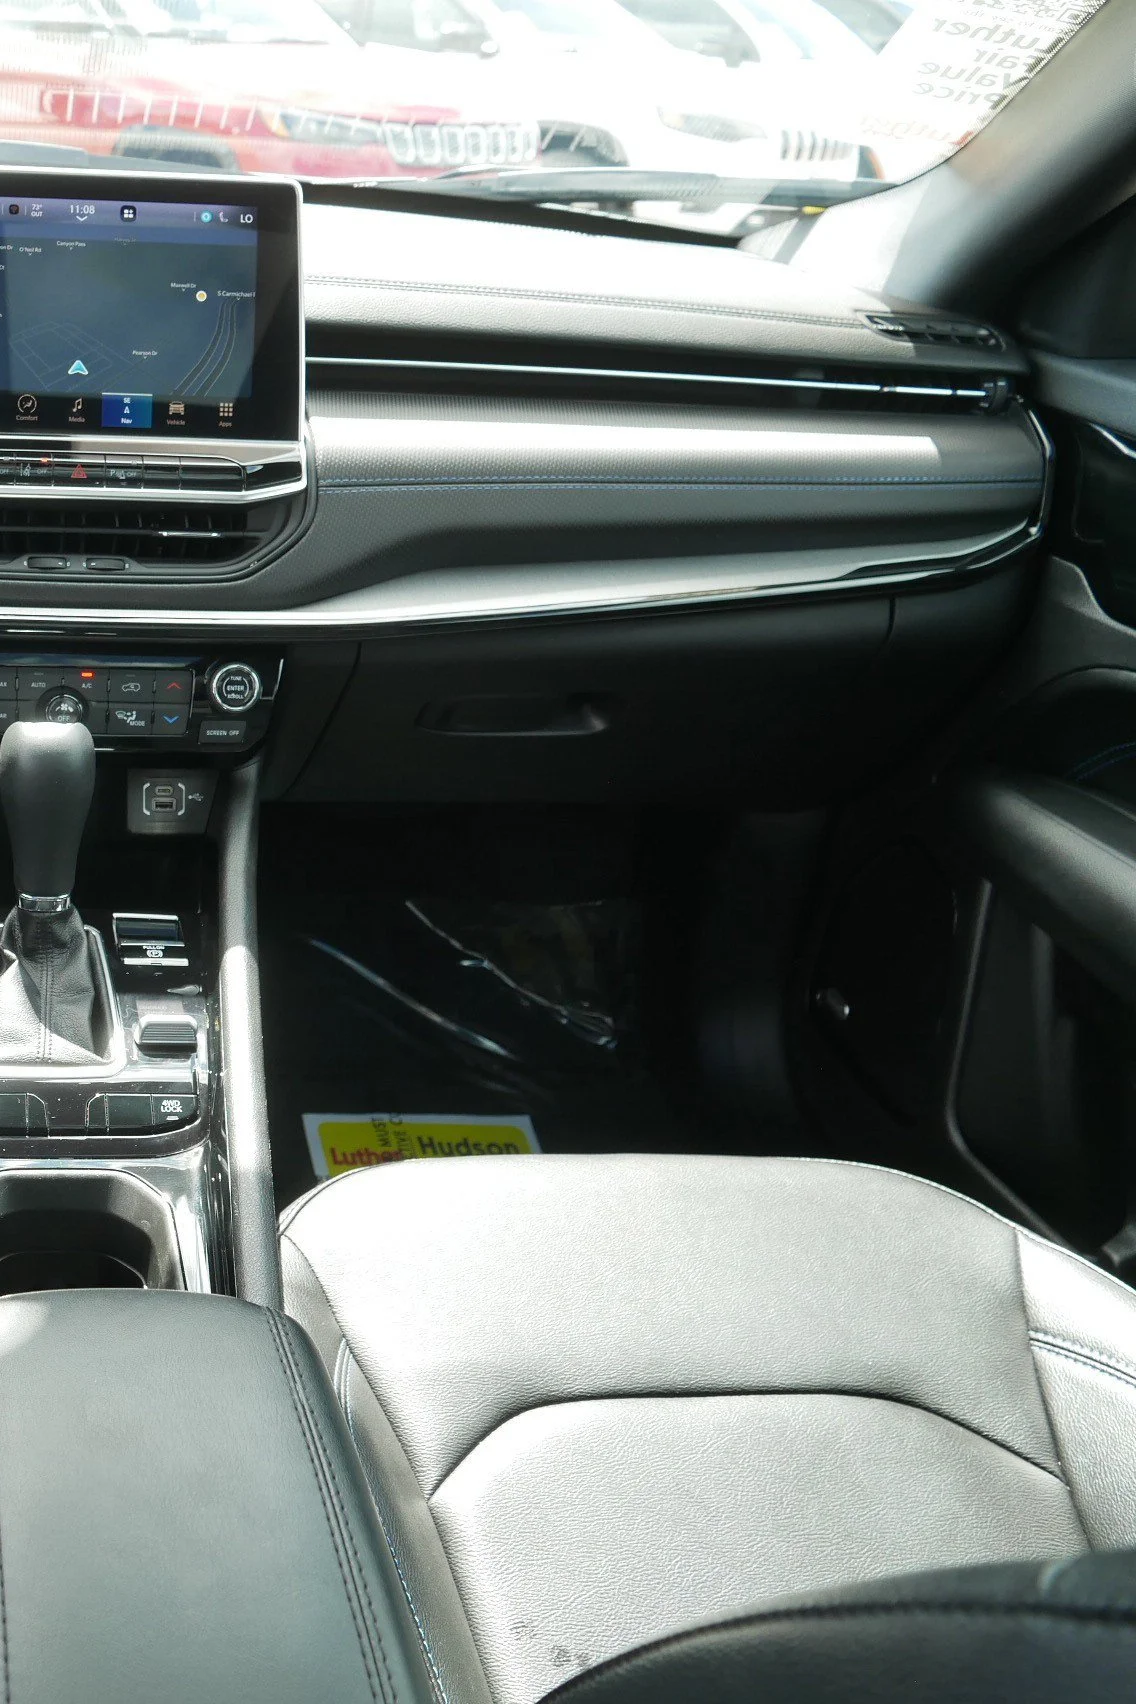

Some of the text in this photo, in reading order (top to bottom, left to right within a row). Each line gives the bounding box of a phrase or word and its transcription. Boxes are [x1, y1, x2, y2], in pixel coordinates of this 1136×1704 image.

[70, 204, 95, 215] 11:08
[240, 214, 254, 224] LO
[222, 290, 253, 298] Carmichael
[16, 414, 38, 422] Comfort
[121, 417, 133, 425] Nav
[166, 418, 186, 426] Vehicle
[218, 420, 233, 428] Apps
[417, 1135, 520, 1158] Hudson
